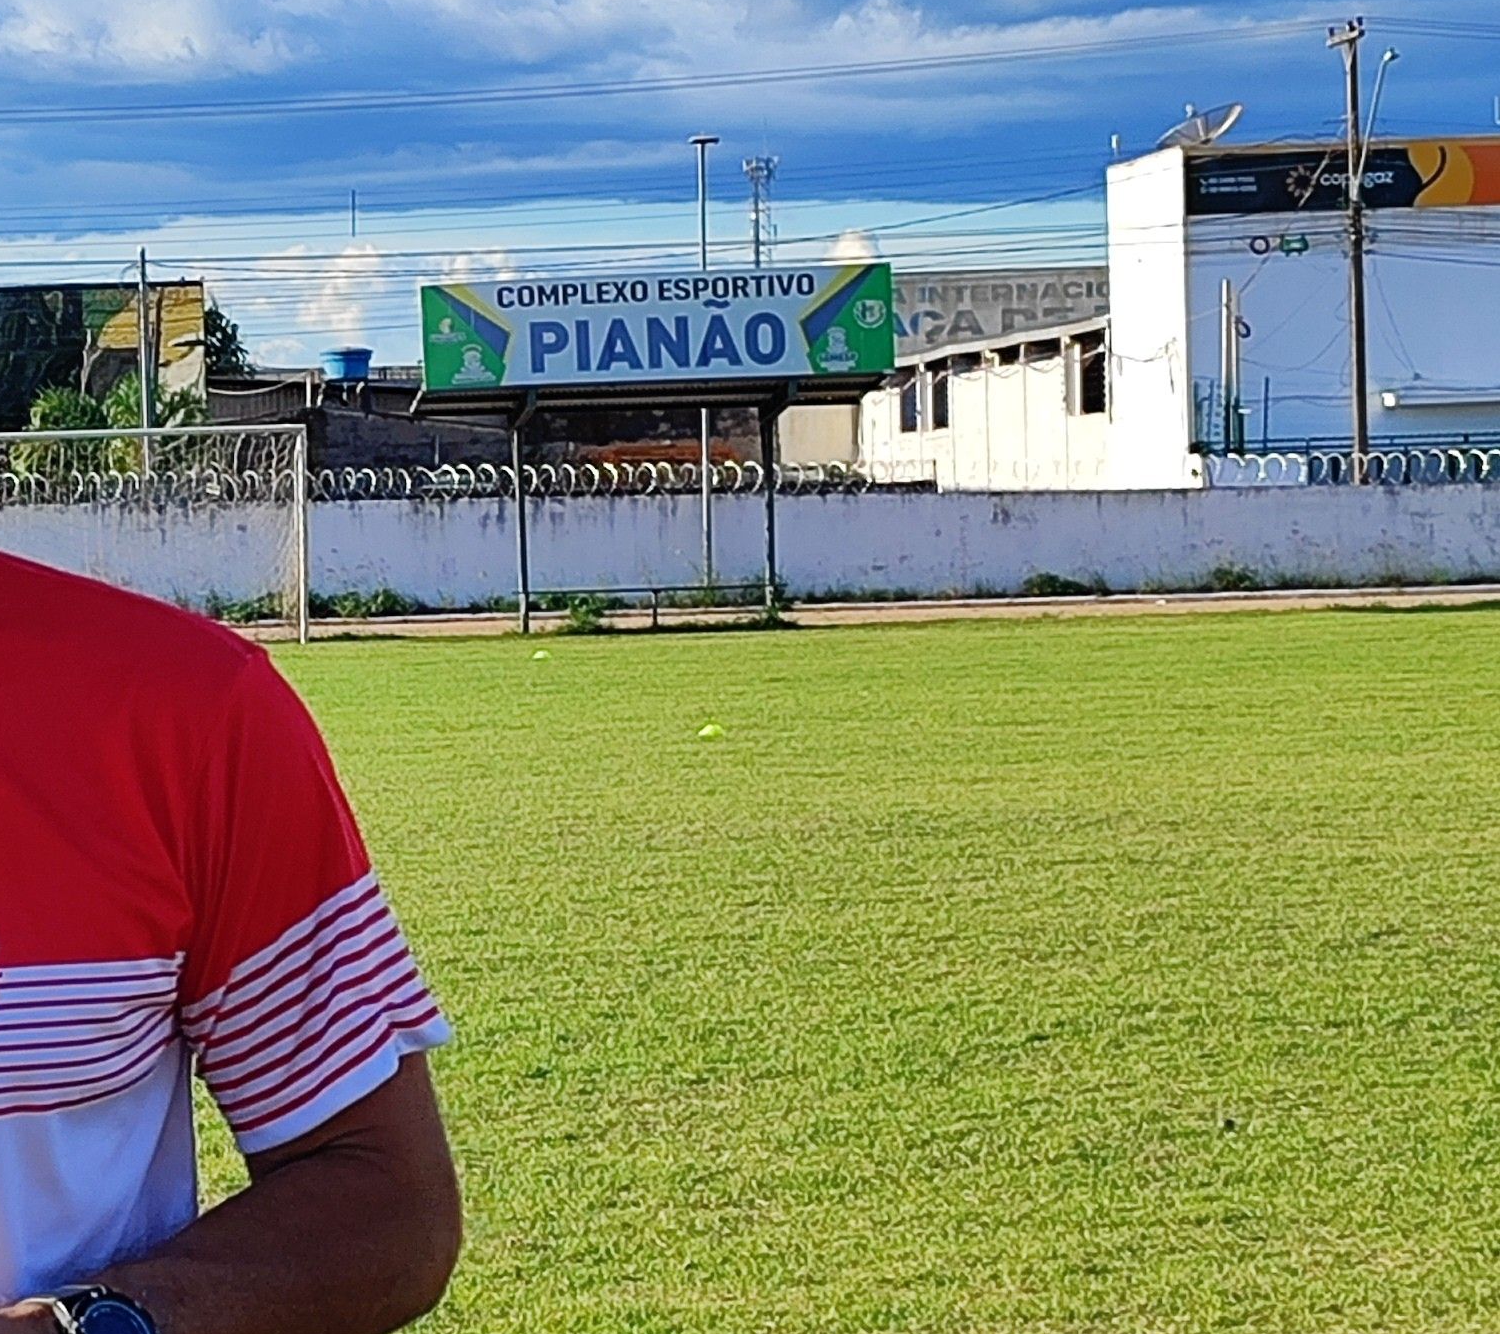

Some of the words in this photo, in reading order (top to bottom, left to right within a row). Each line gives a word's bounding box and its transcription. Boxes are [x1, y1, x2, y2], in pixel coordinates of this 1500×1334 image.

[1320, 172, 1394, 188] copgaz
[497, 280, 649, 309] COMPLEXO
[658, 273, 814, 301] ESPORTIVO
[529, 299, 786, 374] PIANÃO
